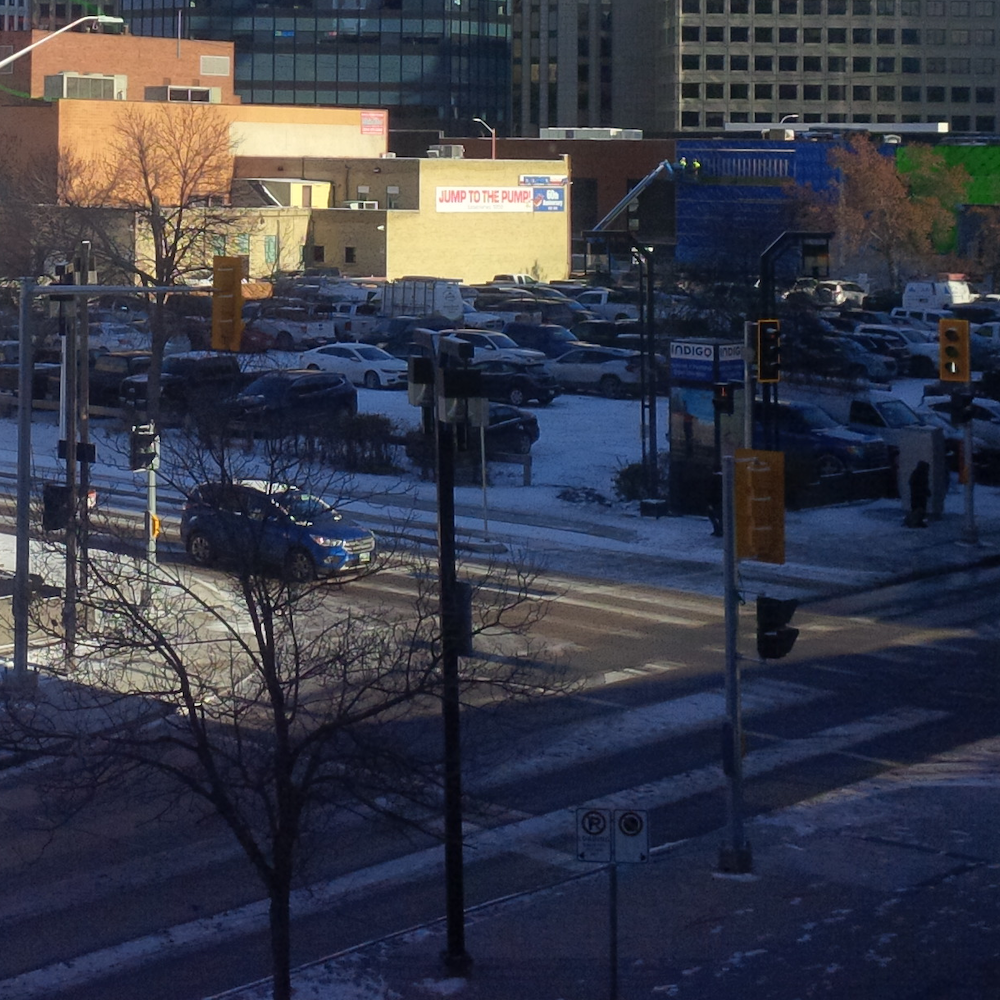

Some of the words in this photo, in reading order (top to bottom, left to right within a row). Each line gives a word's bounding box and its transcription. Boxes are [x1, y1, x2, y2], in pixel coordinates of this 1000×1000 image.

[439, 190, 467, 203] JUMP
[468, 190, 480, 203] TO
[482, 190, 500, 203] THE
[502, 190, 531, 203] PUMP!
[672, 345, 712, 357] INDIGO
